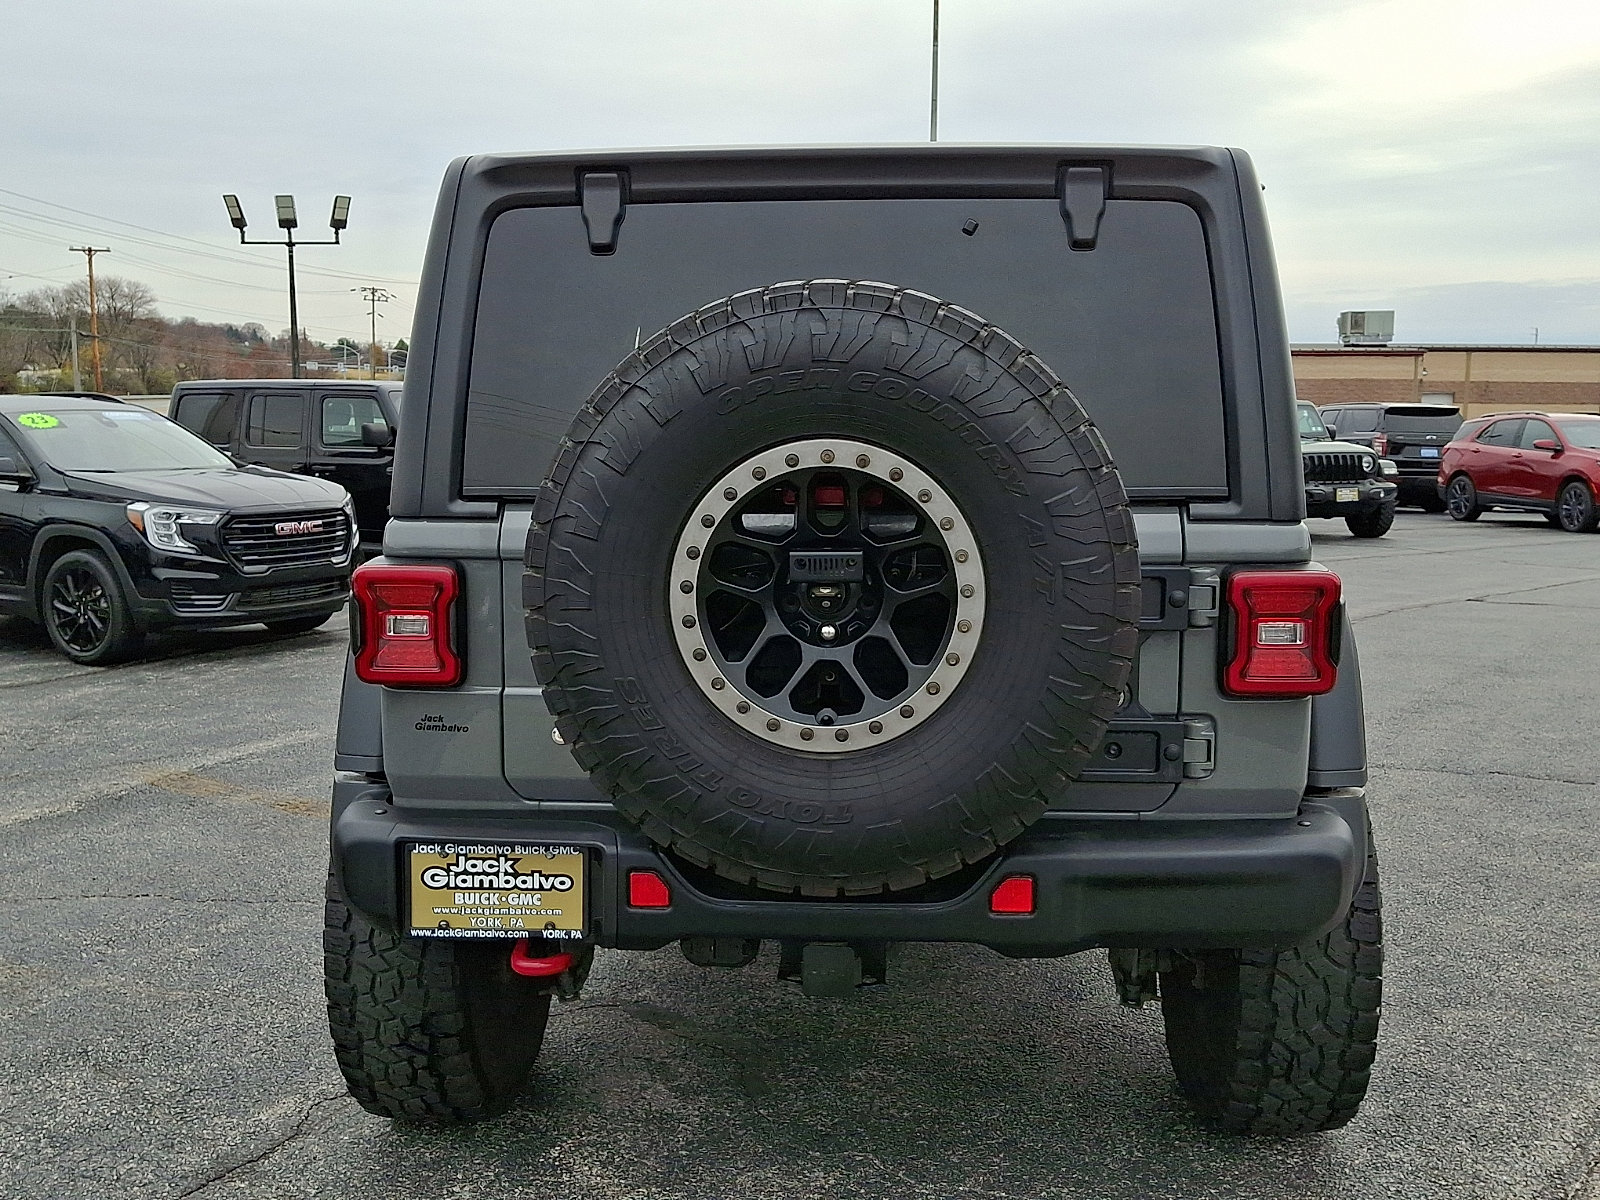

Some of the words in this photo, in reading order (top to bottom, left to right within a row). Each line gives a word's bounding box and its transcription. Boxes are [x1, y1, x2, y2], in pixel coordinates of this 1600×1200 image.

[715, 368, 840, 416] OPEN
[846, 370, 1031, 497] COUNTRY
[275, 520, 323, 535] GMC
[421, 714, 444, 722] Jack
[414, 722, 469, 733] Giambalvo
[613, 676, 724, 793] TIRES
[725, 785, 854, 825] TOYO
[412, 843, 441, 854] Jack
[445, 843, 511, 855] Giambalvo
[514, 845, 547, 855] Buick
[549, 845, 580, 855] GMC
[449, 856, 515, 873] Jack
[423, 868, 572, 890] Giambalvo
[433, 906, 562, 916] www.jackgiambalvo.com
[470, 917, 506, 928] YORK,
[510, 918, 524, 928] PA
[411, 928, 529, 939] www.JackGiambalvo.com
[571, 929, 583, 939] PA
